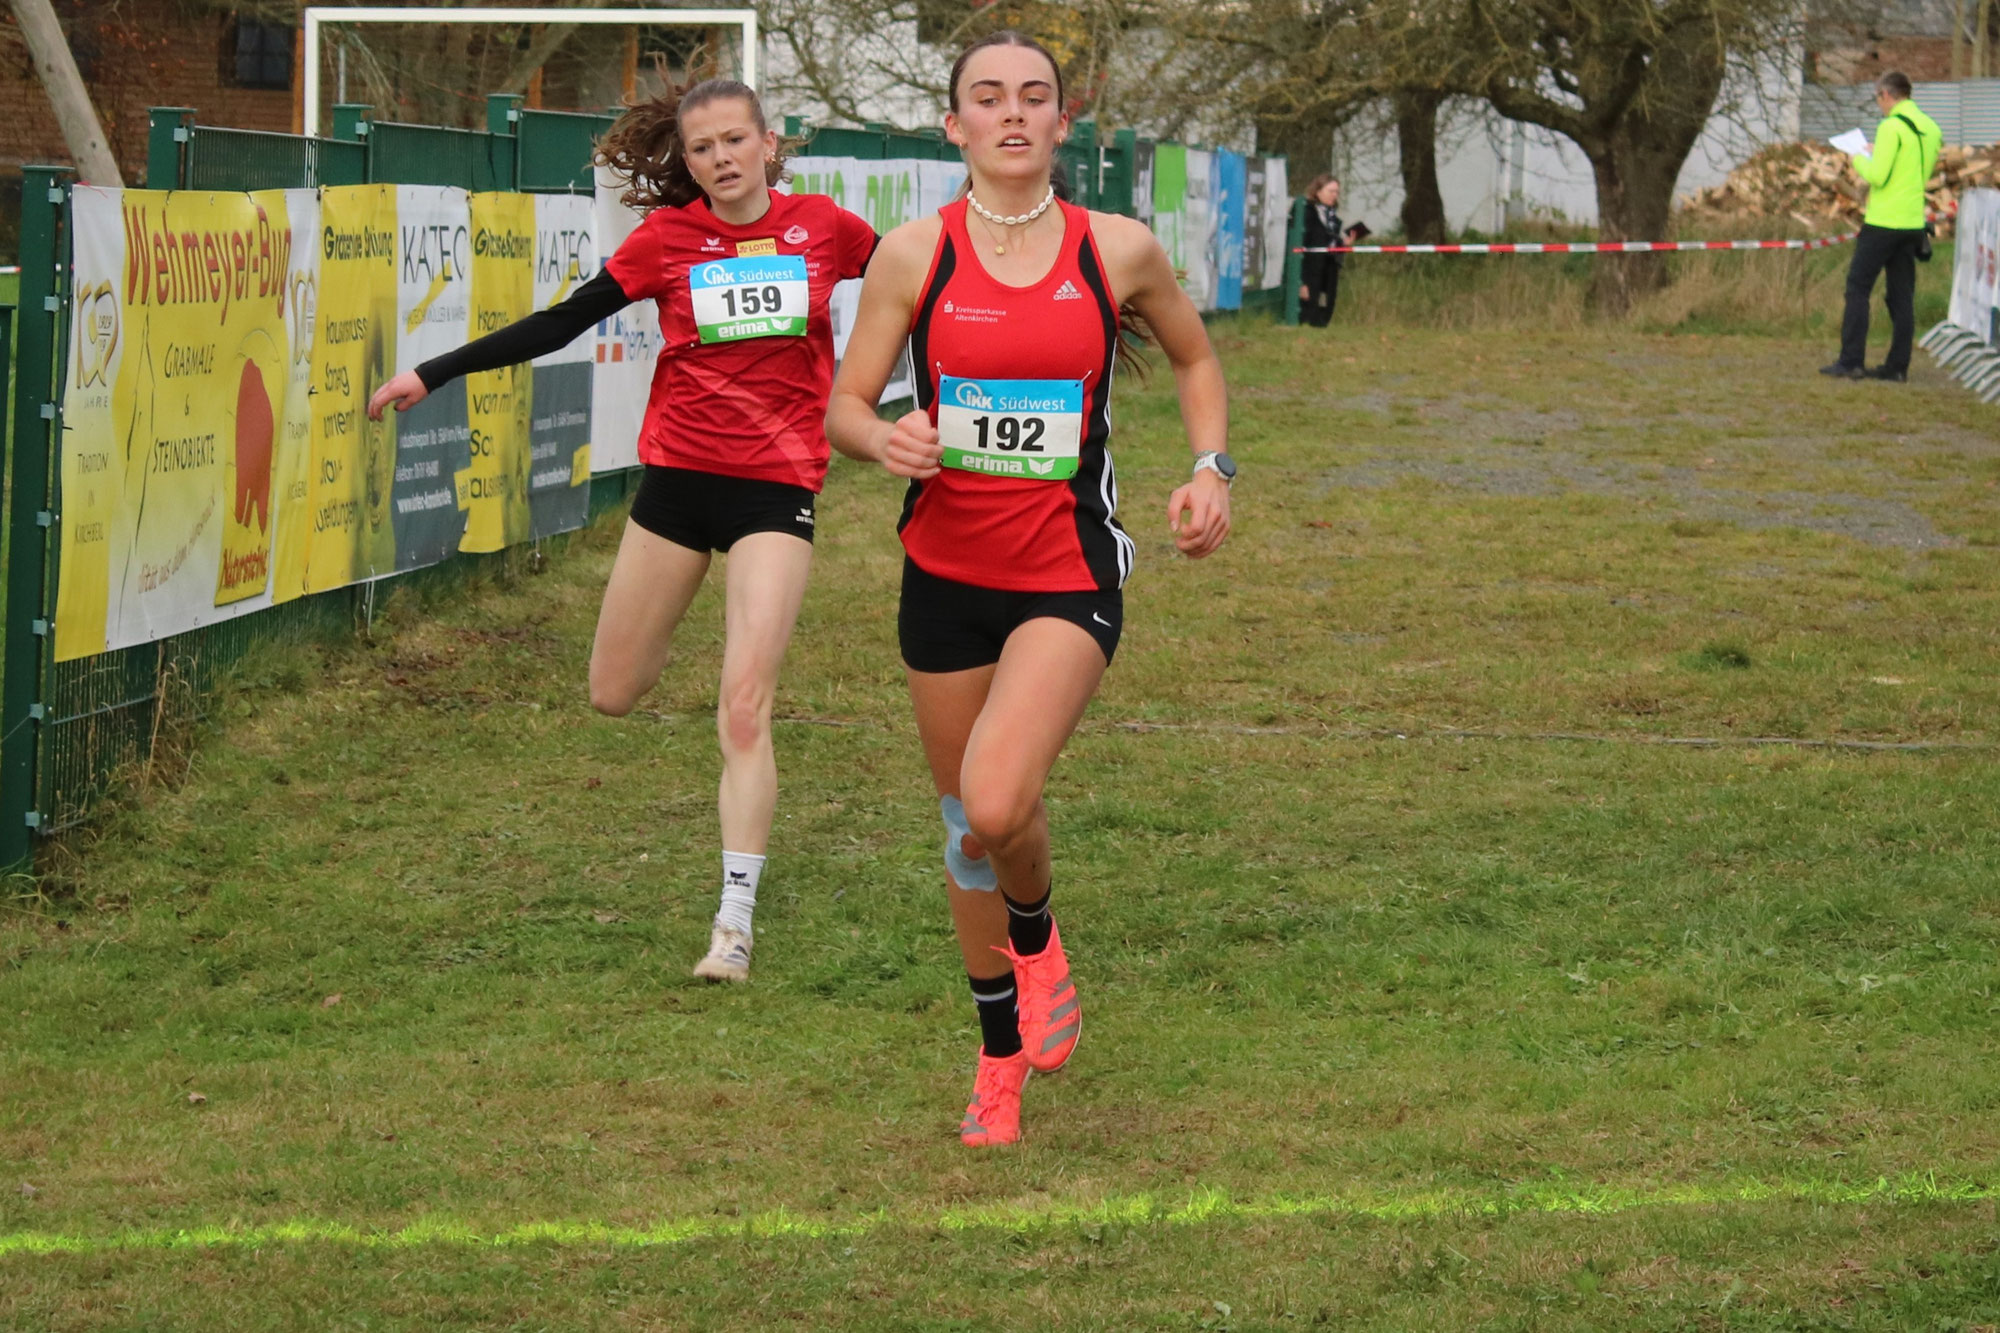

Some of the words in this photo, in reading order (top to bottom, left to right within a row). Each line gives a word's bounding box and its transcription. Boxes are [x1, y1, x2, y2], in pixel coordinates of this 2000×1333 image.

[403, 225, 467, 284] KATEC
[538, 229, 591, 283] KATEC
[749, 242, 775, 252] LOTTO
[122, 205, 291, 326] Wehmeyer-Bug
[739, 268, 794, 283] Südwest
[721, 285, 782, 317] 159
[1053, 292, 1082, 301] adidas
[954, 314, 999, 323] Altenkirchen
[955, 306, 1007, 316] Kreissparkasse
[717, 320, 769, 338] erima
[164, 342, 215, 378] GRABMALE
[998, 396, 1066, 411] Südwest
[972, 415, 1046, 452] 192
[152, 433, 214, 474] STEINOBJEKTE
[961, 453, 1021, 475] erima
